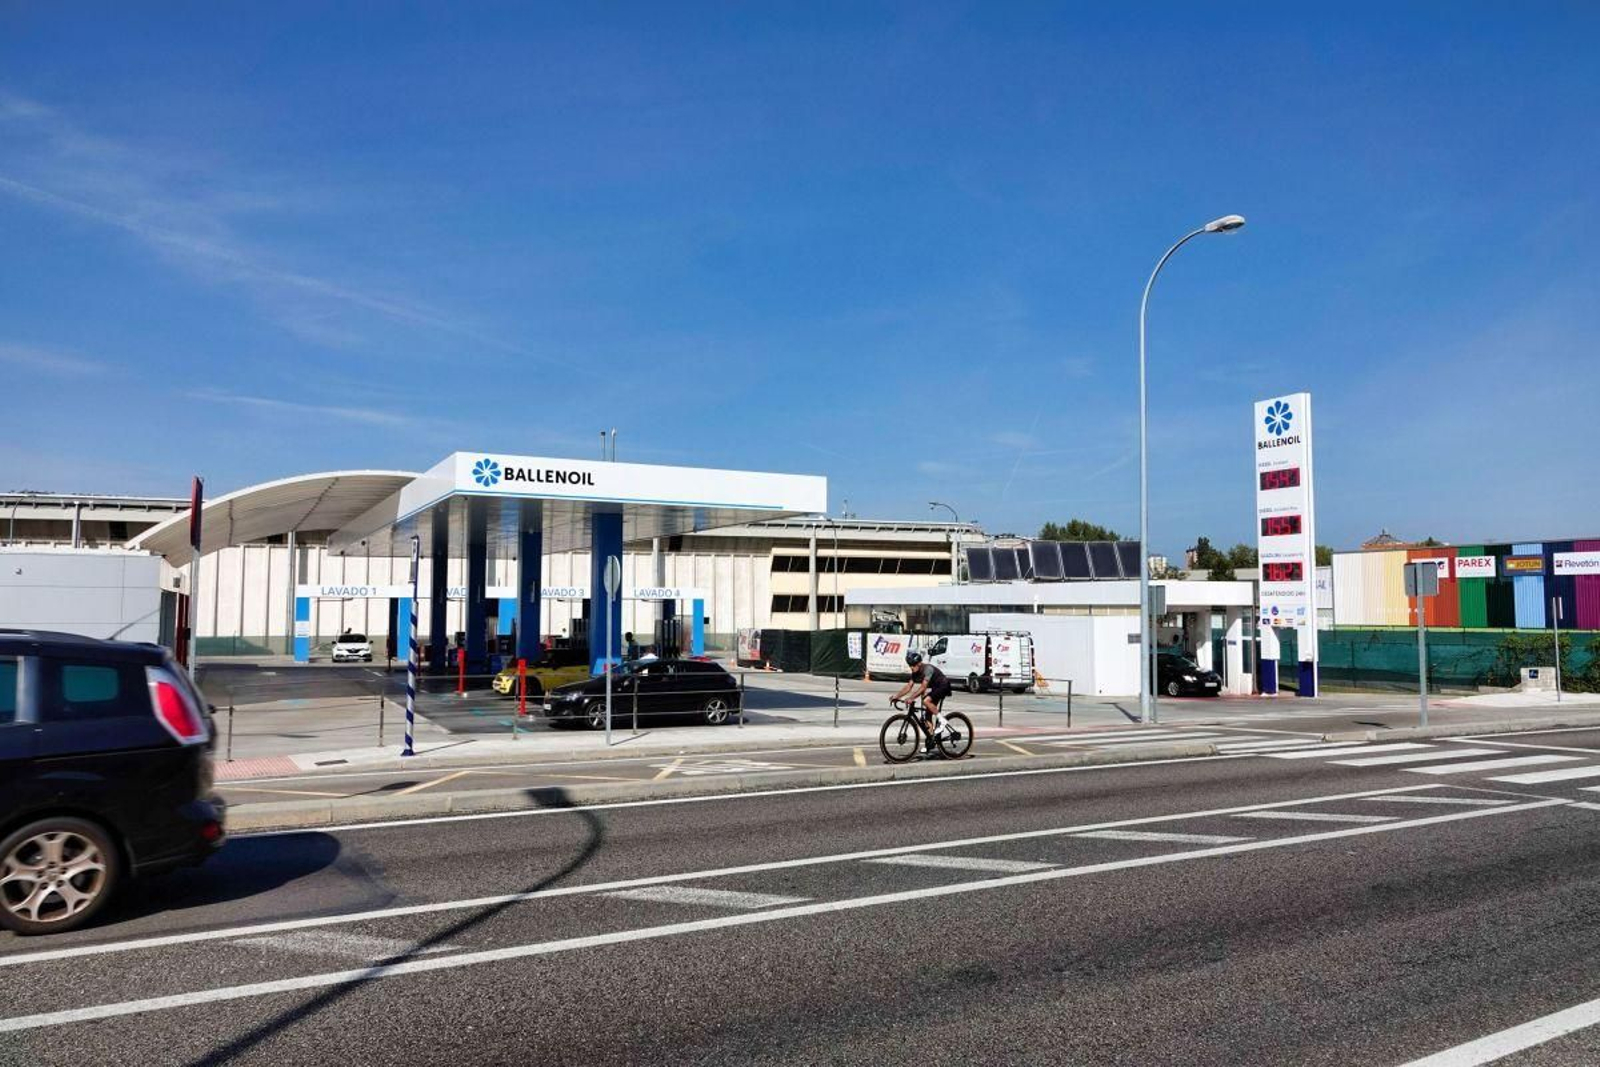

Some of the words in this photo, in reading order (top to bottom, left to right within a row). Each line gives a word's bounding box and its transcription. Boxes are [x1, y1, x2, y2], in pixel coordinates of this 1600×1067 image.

[1258, 436, 1301, 450] BALLENOIL
[504, 467, 595, 486] BALLENOIL
[1457, 558, 1492, 567] PAREX
[1564, 559, 1600, 568] Revetón
[321, 586, 368, 596] LAVADO
[371, 587, 376, 596] 1
[541, 588, 577, 597] AVADO
[578, 588, 585, 597] 3
[633, 588, 673, 598] LAVADO
[674, 588, 681, 597] 4
